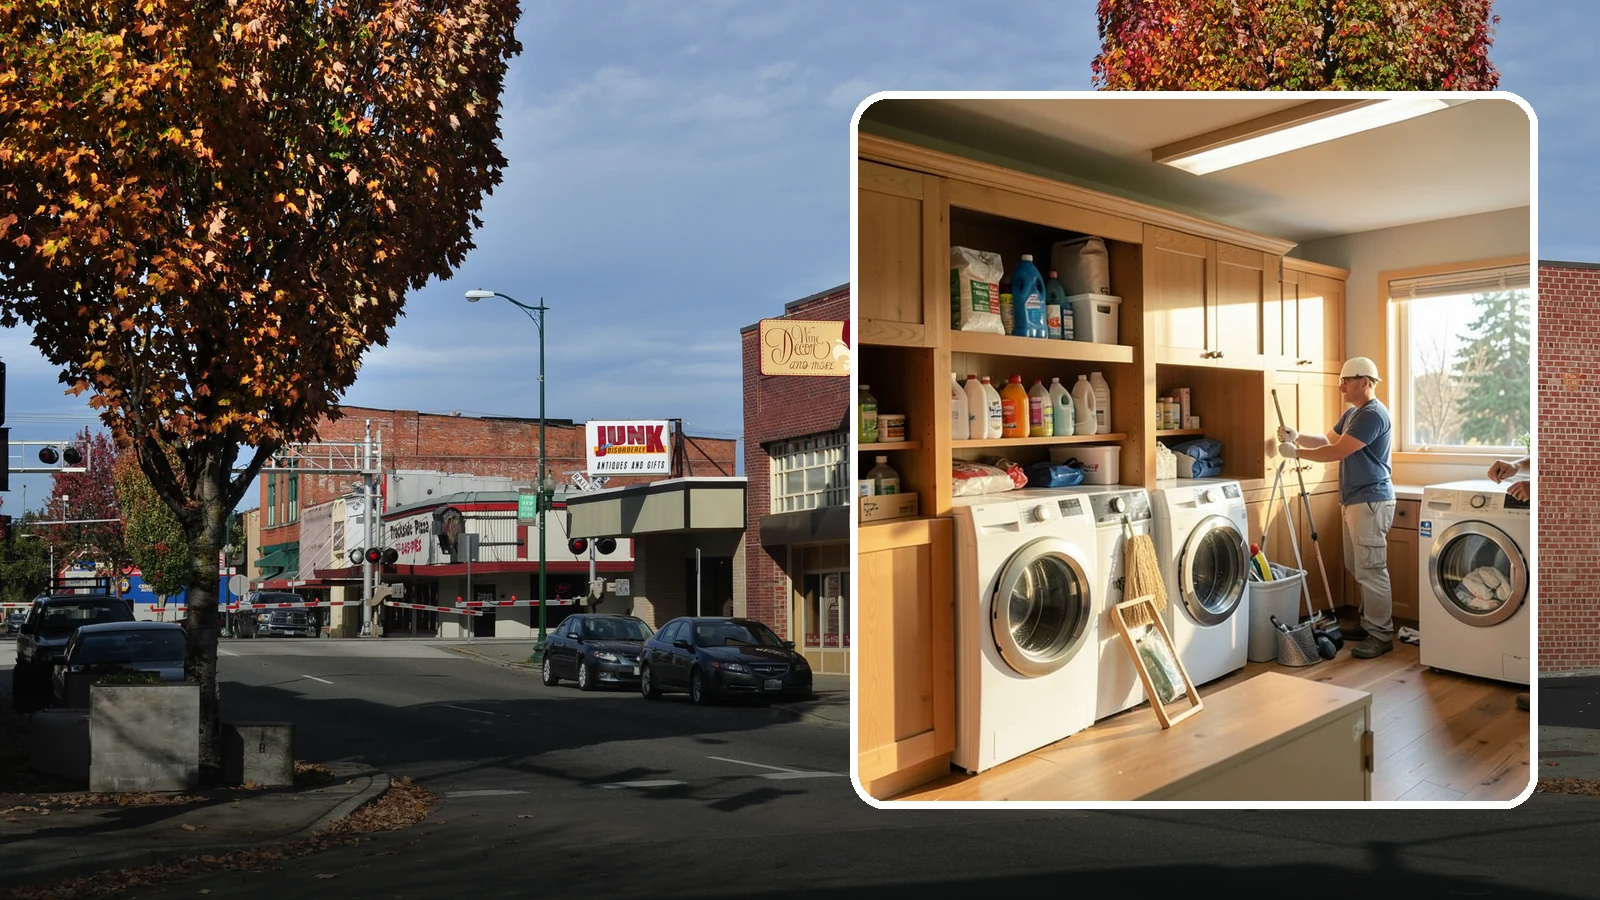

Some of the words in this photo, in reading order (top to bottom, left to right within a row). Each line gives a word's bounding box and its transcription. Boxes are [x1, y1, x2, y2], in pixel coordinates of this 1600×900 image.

[595, 425, 665, 457] JUNK
[607, 446, 646, 454] DISORDERLY
[597, 461, 628, 470] ANTIQUES
[631, 461, 644, 469] AND
[647, 460, 665, 469] GIFTS
[414, 519, 429, 535] Pizza
